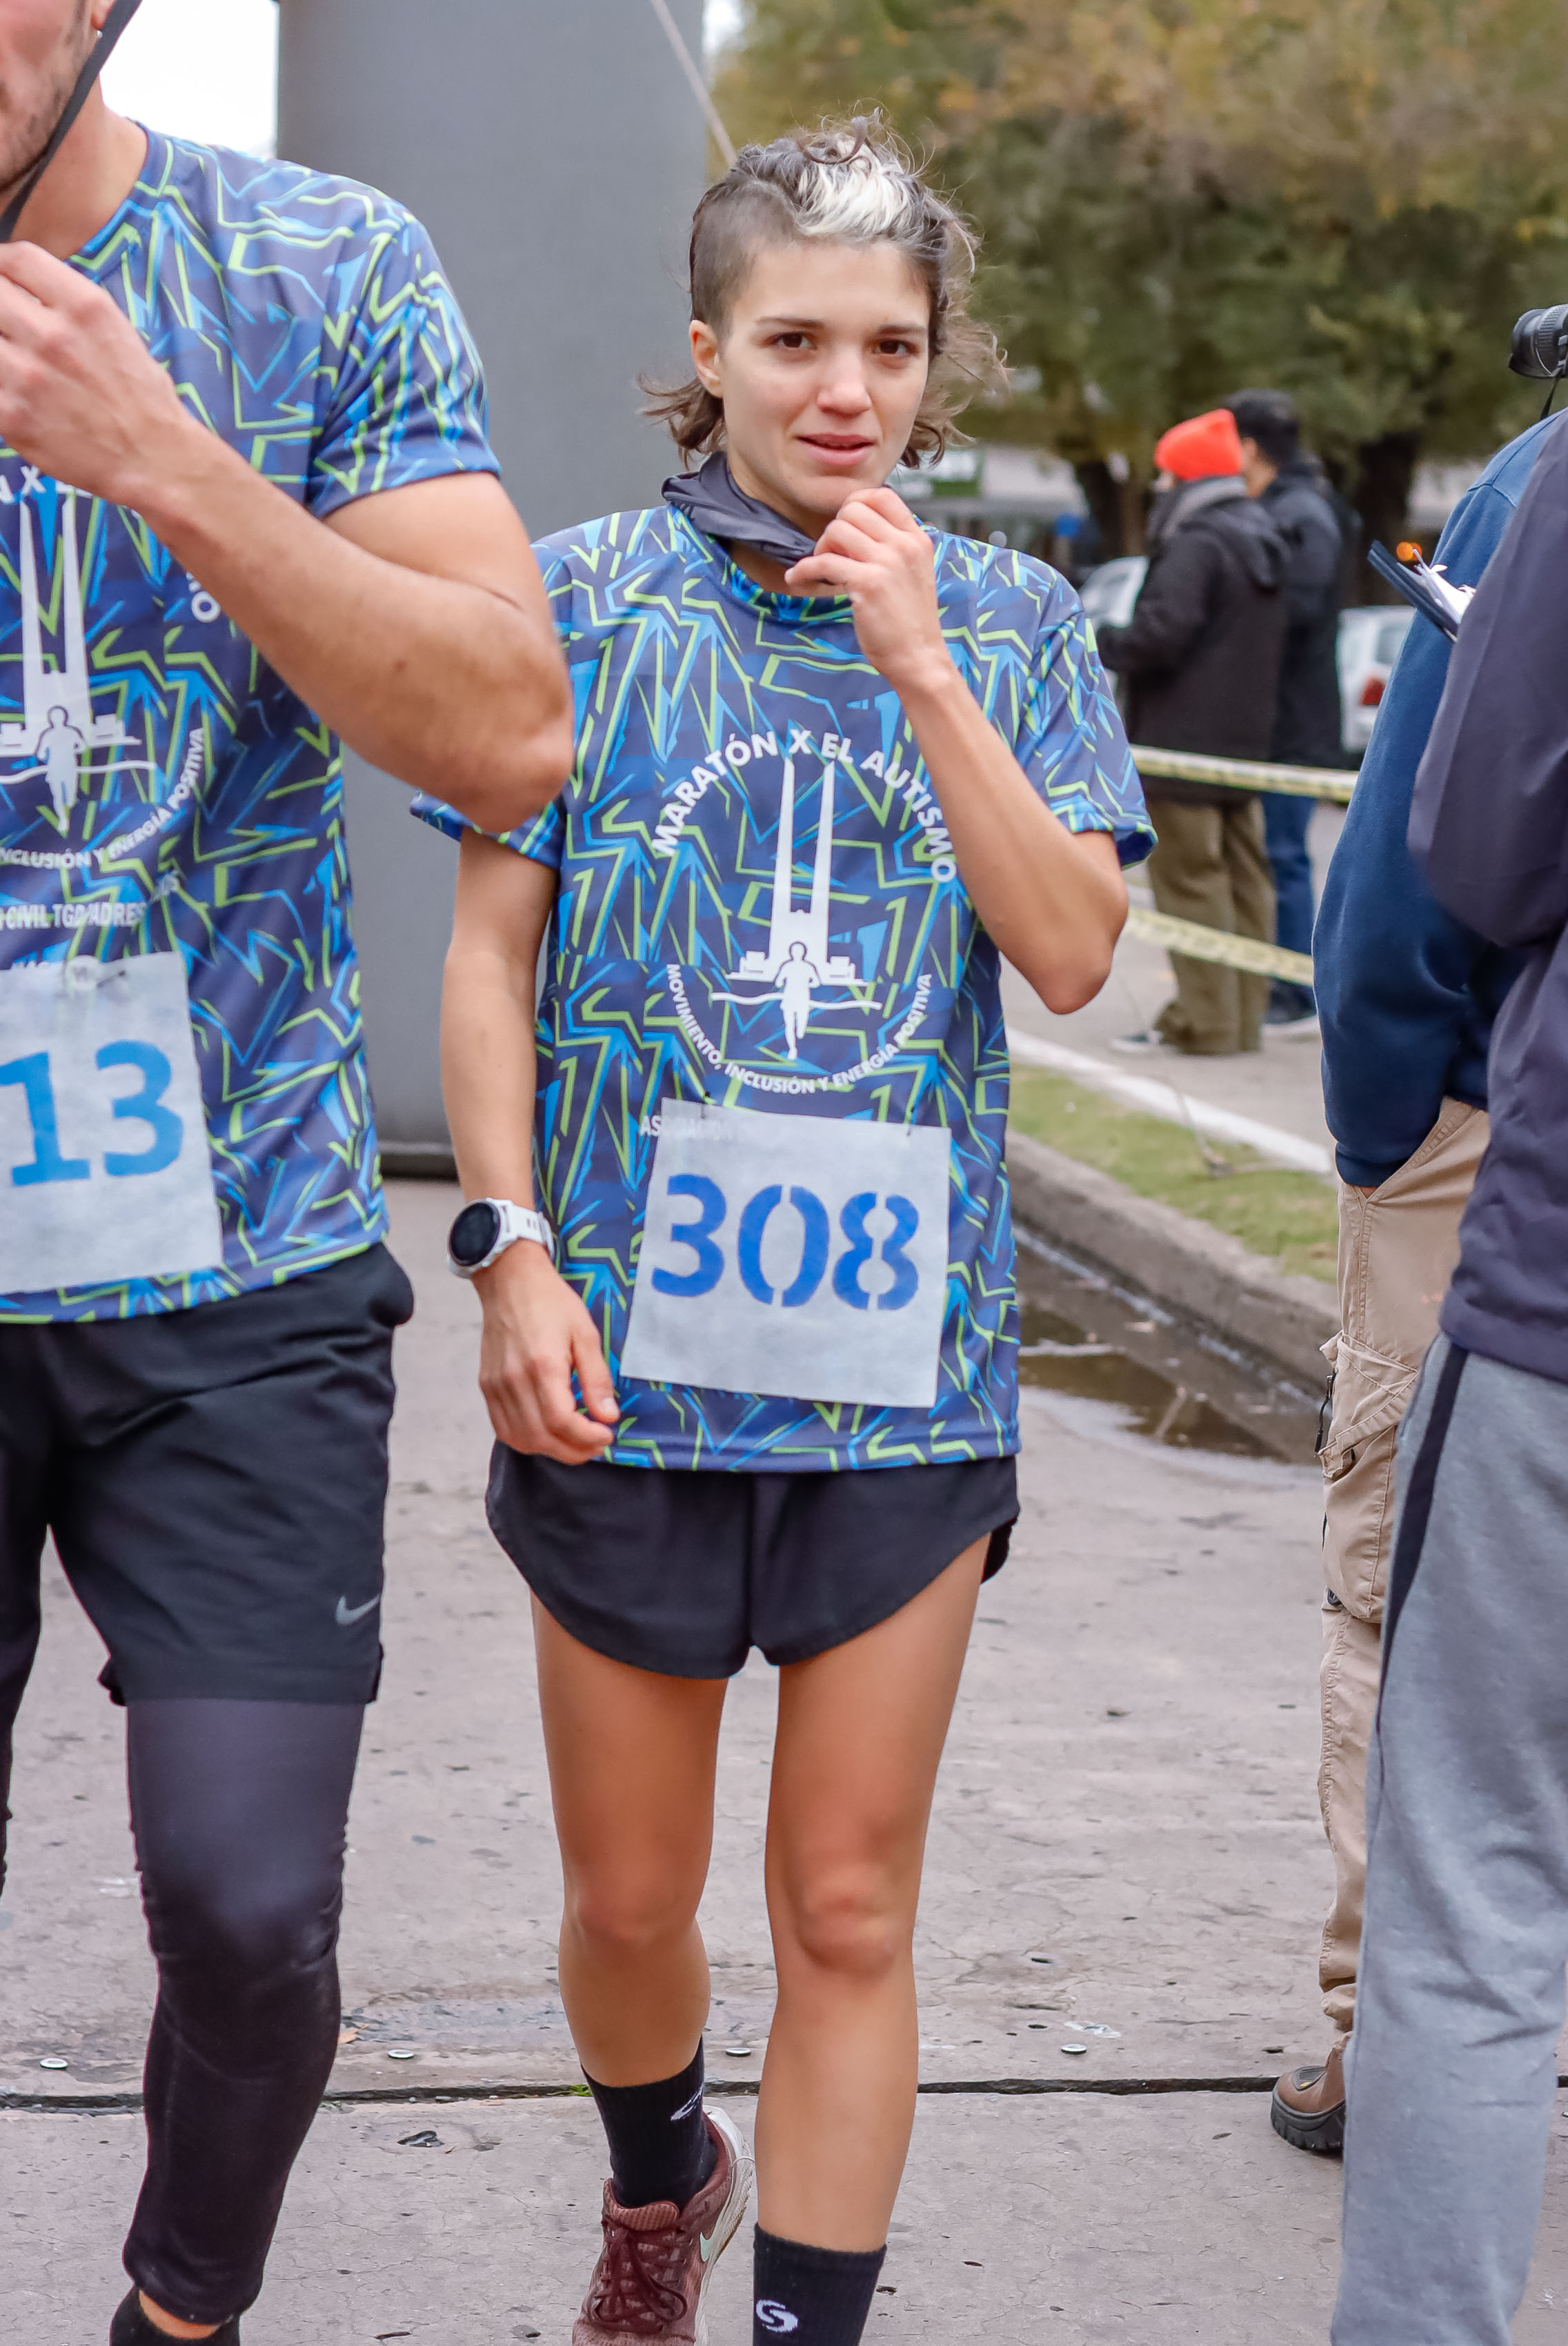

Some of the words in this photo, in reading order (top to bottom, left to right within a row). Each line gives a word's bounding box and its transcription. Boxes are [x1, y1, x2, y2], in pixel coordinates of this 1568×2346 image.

[20, 465, 47, 497] X
[167, 728, 204, 810] POSITIVA
[652, 731, 778, 856] MARATÓN
[788, 728, 812, 755] X
[821, 732, 854, 763] EL
[860, 750, 957, 883] AUTISMO
[666, 964, 724, 1071] MOVIMIENTO,
[725, 1061, 815, 1095] INCLUSIÓN
[817, 1076, 832, 1093] Y
[833, 1041, 898, 1088] ENERGÍA
[893, 973, 933, 1046] POSITIVA
[651, 1174, 920, 1311] 308
